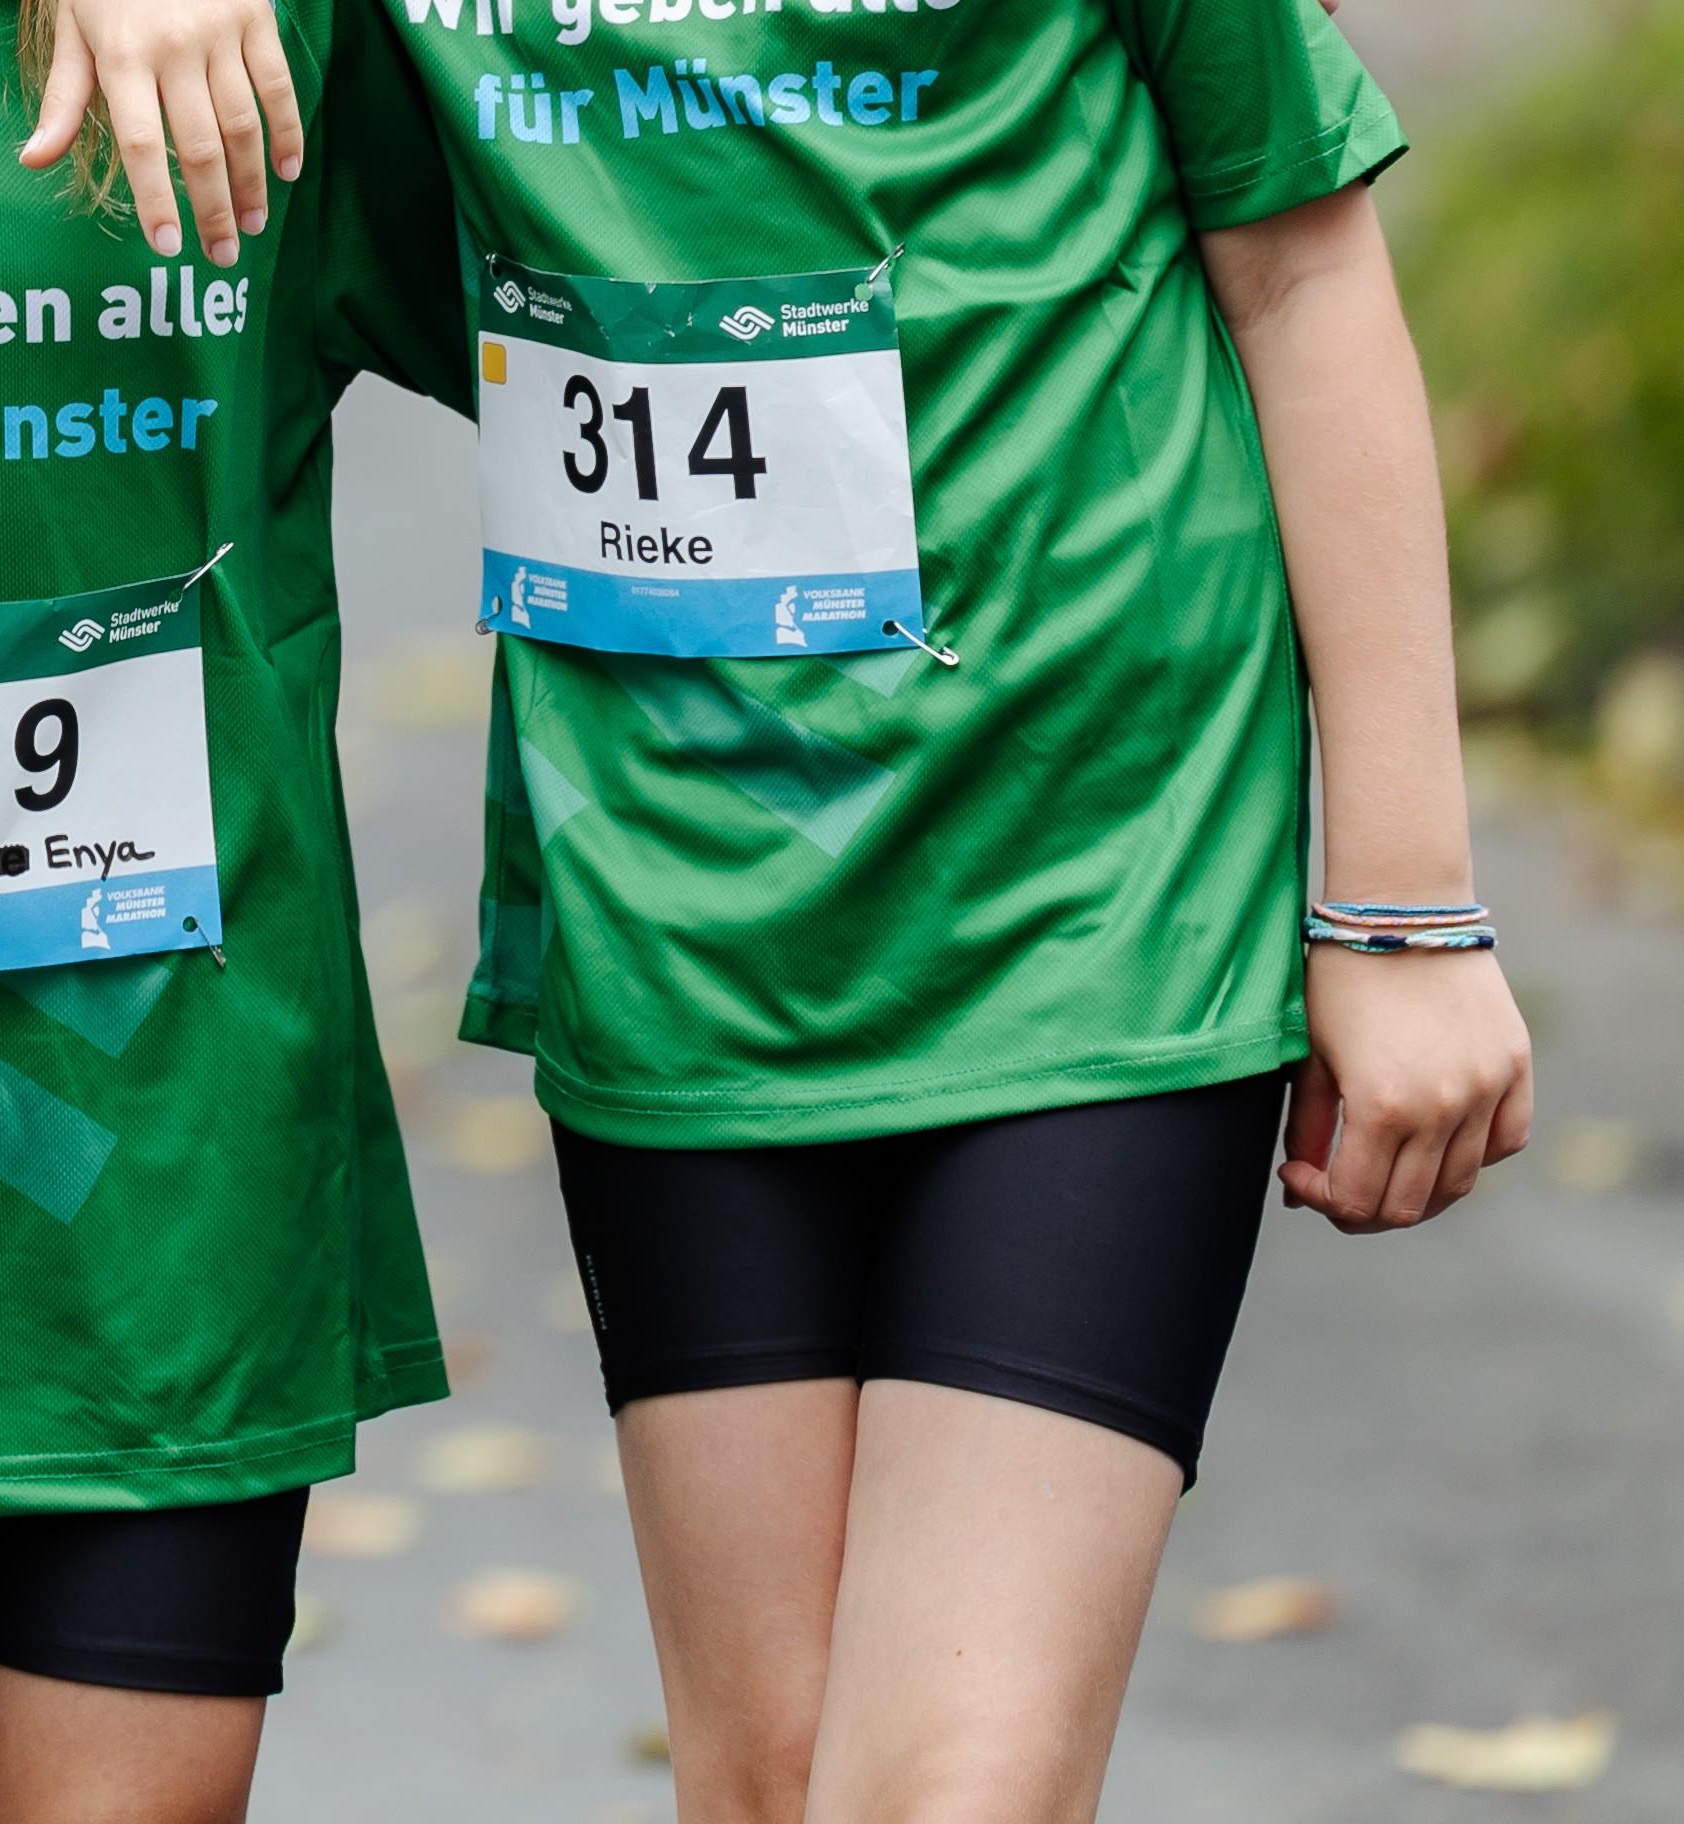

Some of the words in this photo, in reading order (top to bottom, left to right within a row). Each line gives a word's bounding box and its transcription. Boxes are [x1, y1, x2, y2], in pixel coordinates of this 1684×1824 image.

[475, 72, 594, 144] für
[614, 58, 939, 139] Münster
[98, 265, 249, 340] alles
[529, 303, 565, 325] Münster
[780, 298, 870, 320] Stadtwerke
[782, 318, 850, 338] Münster
[562, 374, 767, 501] 314
[600, 521, 714, 565] Rieke
[110, 599, 180, 628] Stadtwerke
[802, 609, 867, 622] MARATHON
[109, 620, 161, 644] Münster
[44, 834, 156, 882] Enya
[107, 885, 166, 901] VOLKSBANK
[115, 896, 166, 912] MÜNSTER
[105, 907, 167, 924] MARATHON
